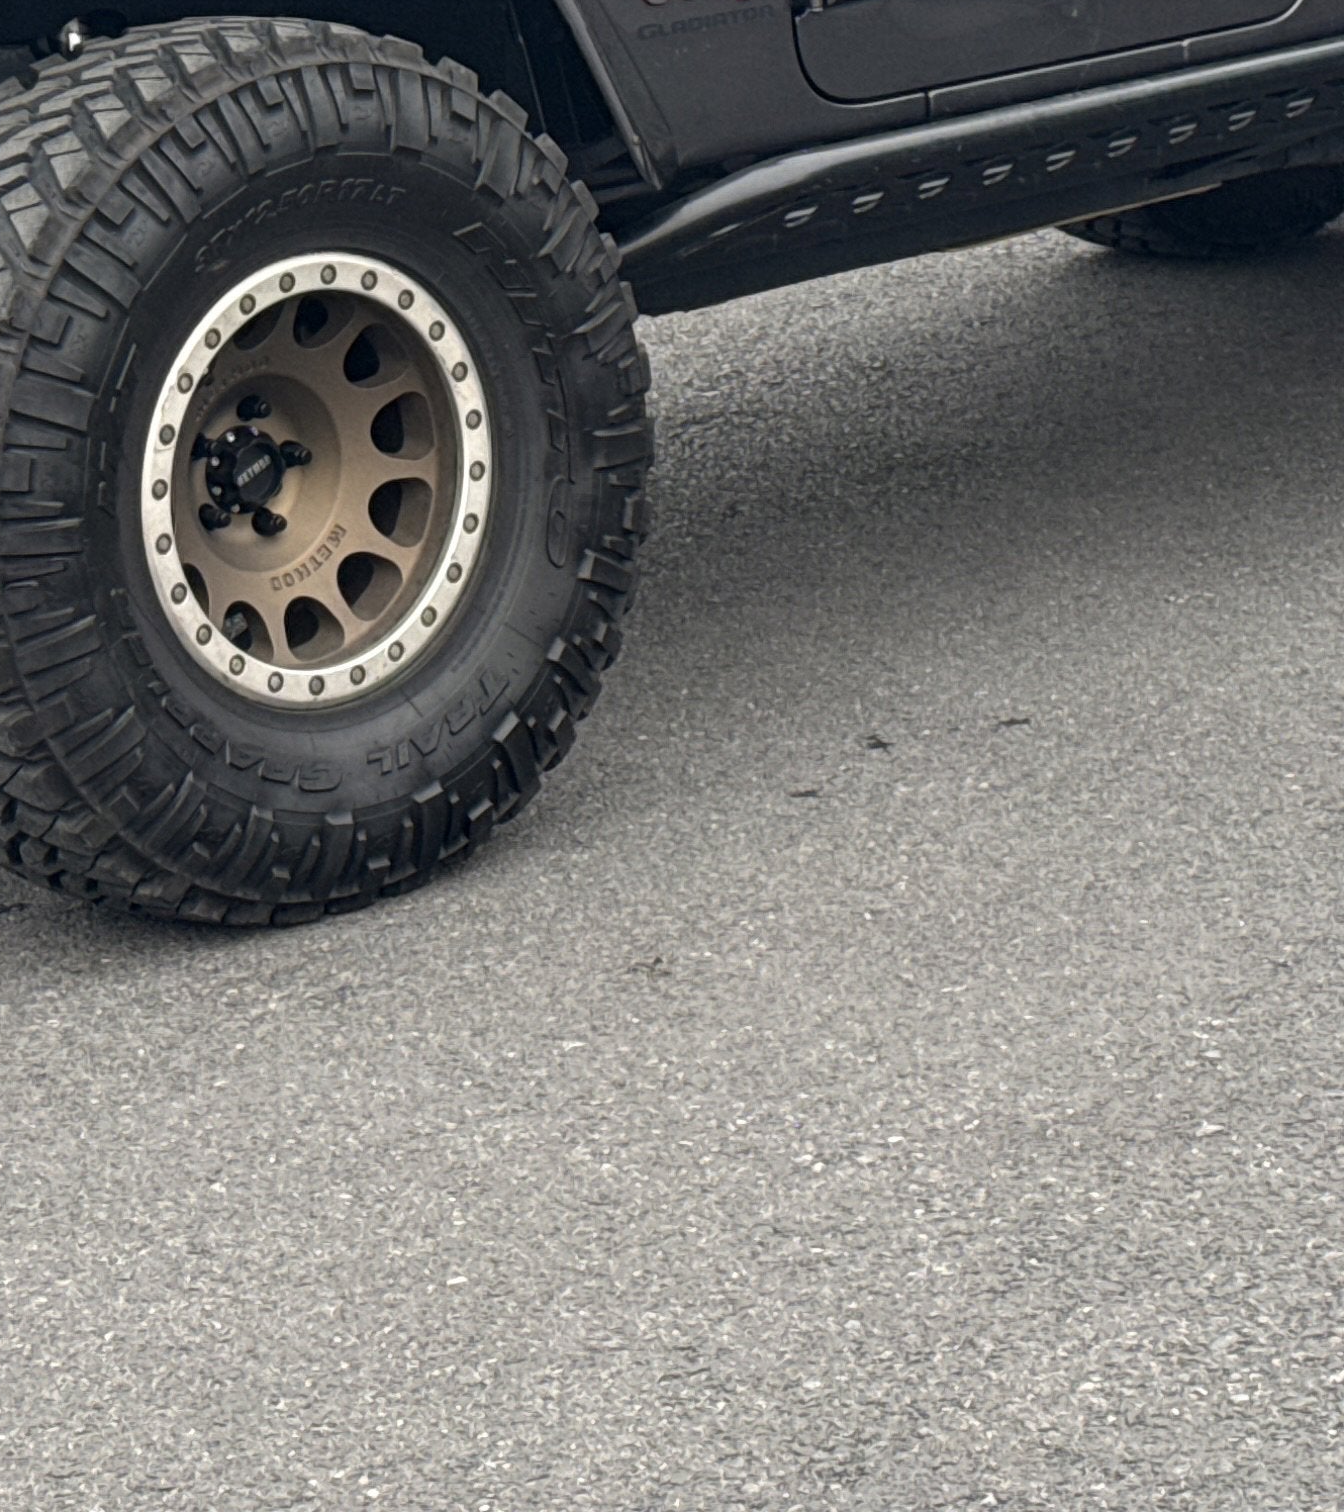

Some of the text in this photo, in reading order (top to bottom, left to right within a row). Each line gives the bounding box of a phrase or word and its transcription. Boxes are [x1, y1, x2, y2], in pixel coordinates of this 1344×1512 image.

[638, 4, 776, 39] GLADIATOR
[269, 523, 347, 591] METHOD
[366, 665, 510, 776] TRAIL
